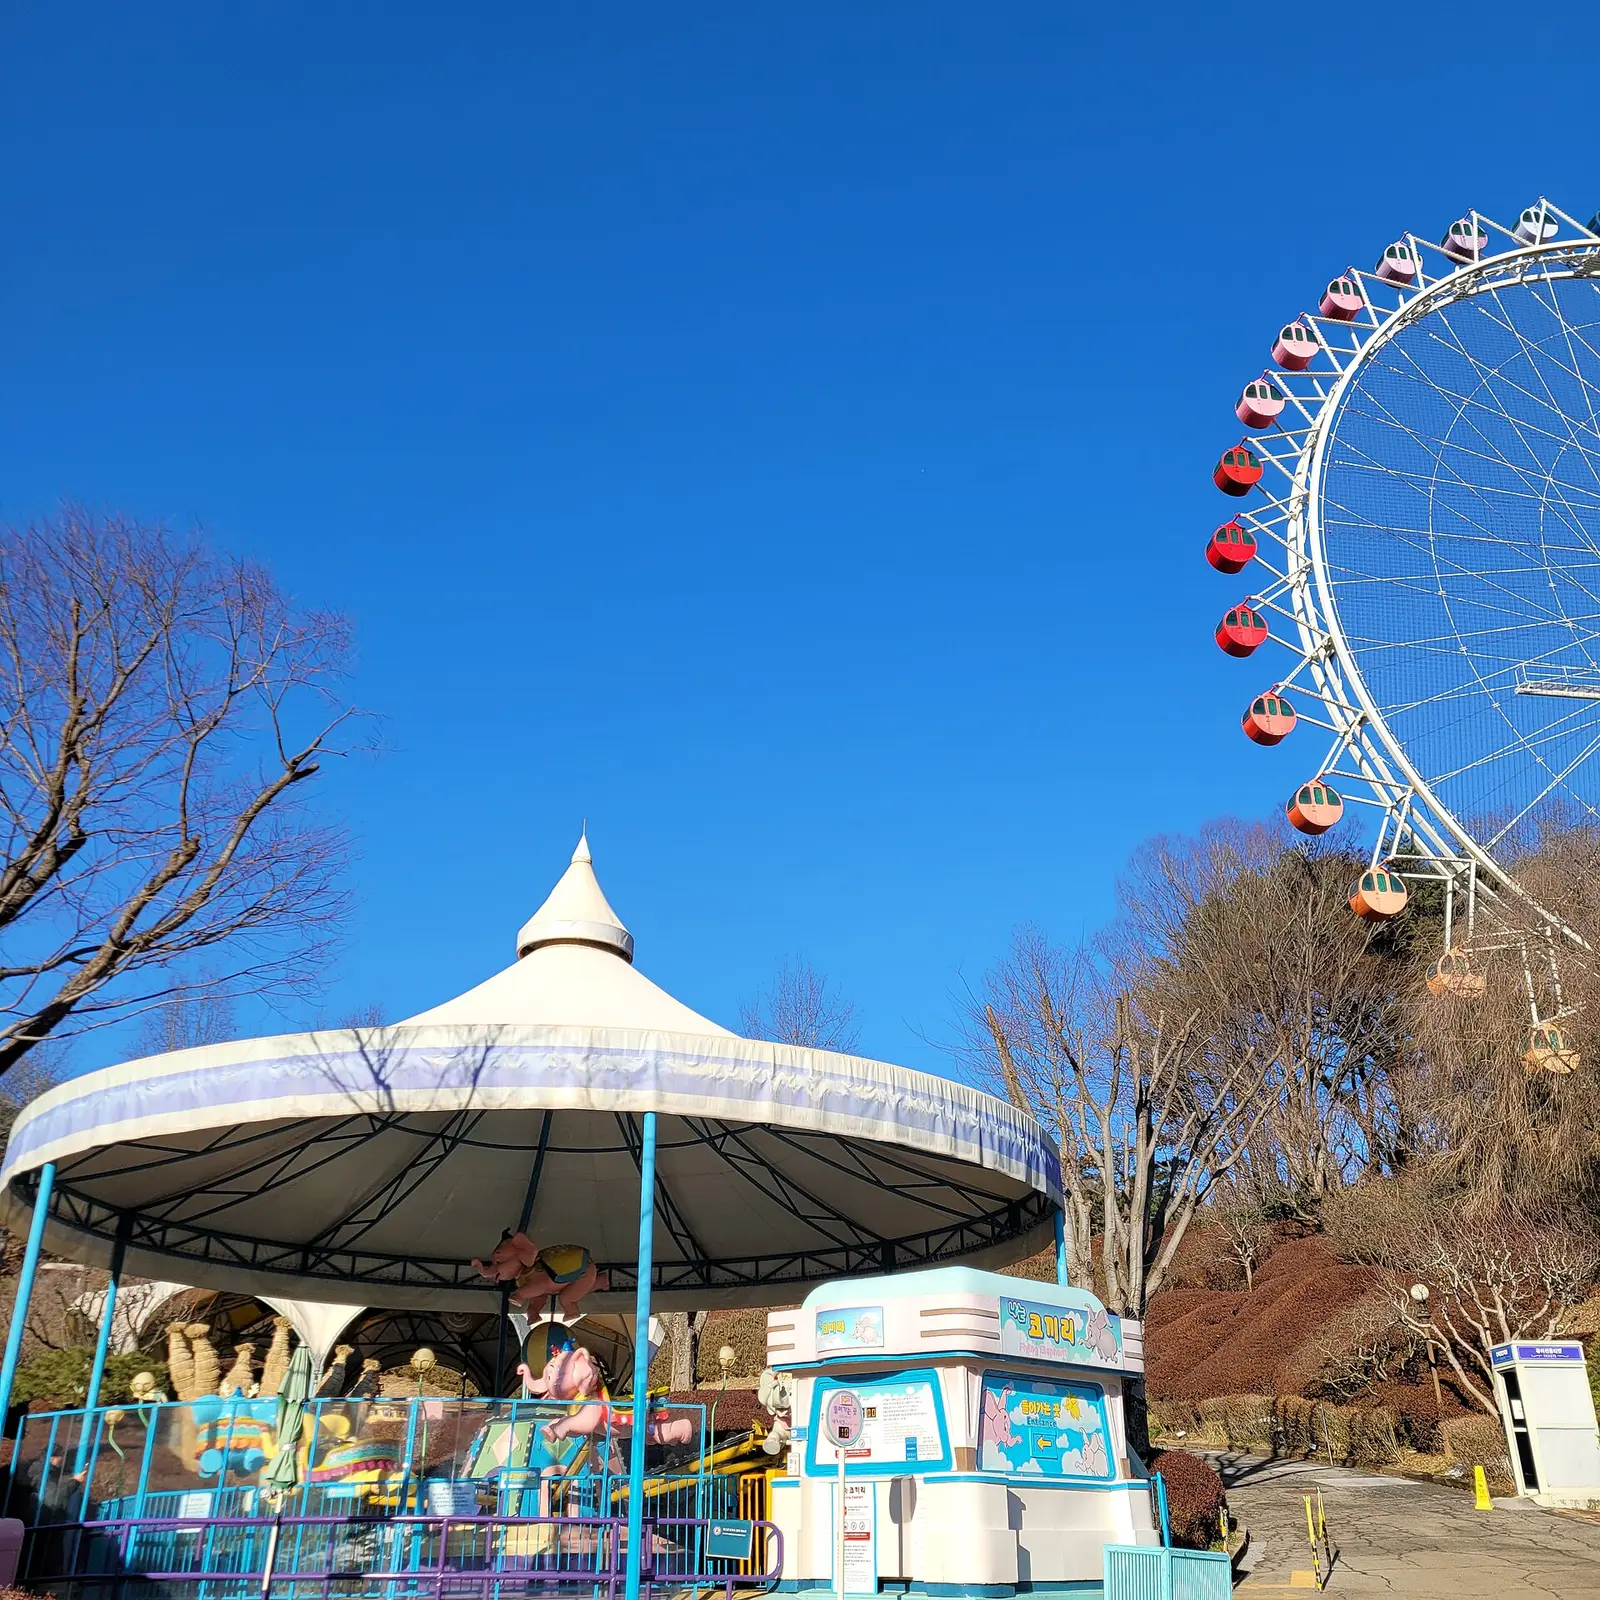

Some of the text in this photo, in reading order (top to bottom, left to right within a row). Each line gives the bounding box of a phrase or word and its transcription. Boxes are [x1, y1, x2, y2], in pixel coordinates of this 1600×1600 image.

[1008, 1301, 1075, 1346] 나는 코끼리
[1021, 1399, 1060, 1418] 들어가는 곳
[1027, 1417, 1057, 1427] Entrance
